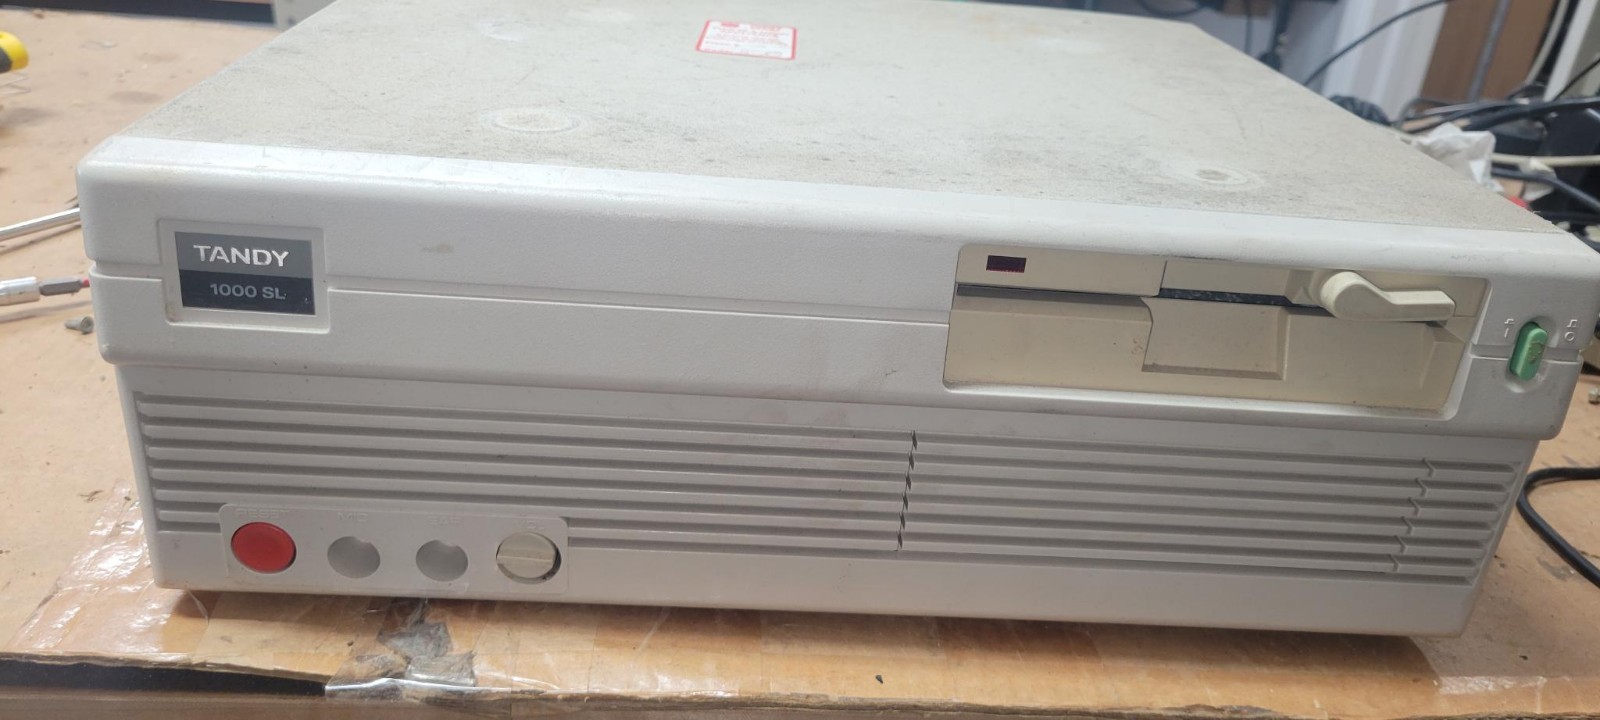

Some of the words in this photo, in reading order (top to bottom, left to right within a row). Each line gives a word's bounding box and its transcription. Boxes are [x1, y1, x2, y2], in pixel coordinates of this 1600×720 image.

[193, 244, 289, 267] TANDY
[210, 283, 258, 298] 1000
[262, 286, 286, 300] SL
[235, 507, 290, 519] RESET
[337, 511, 368, 523] MIC
